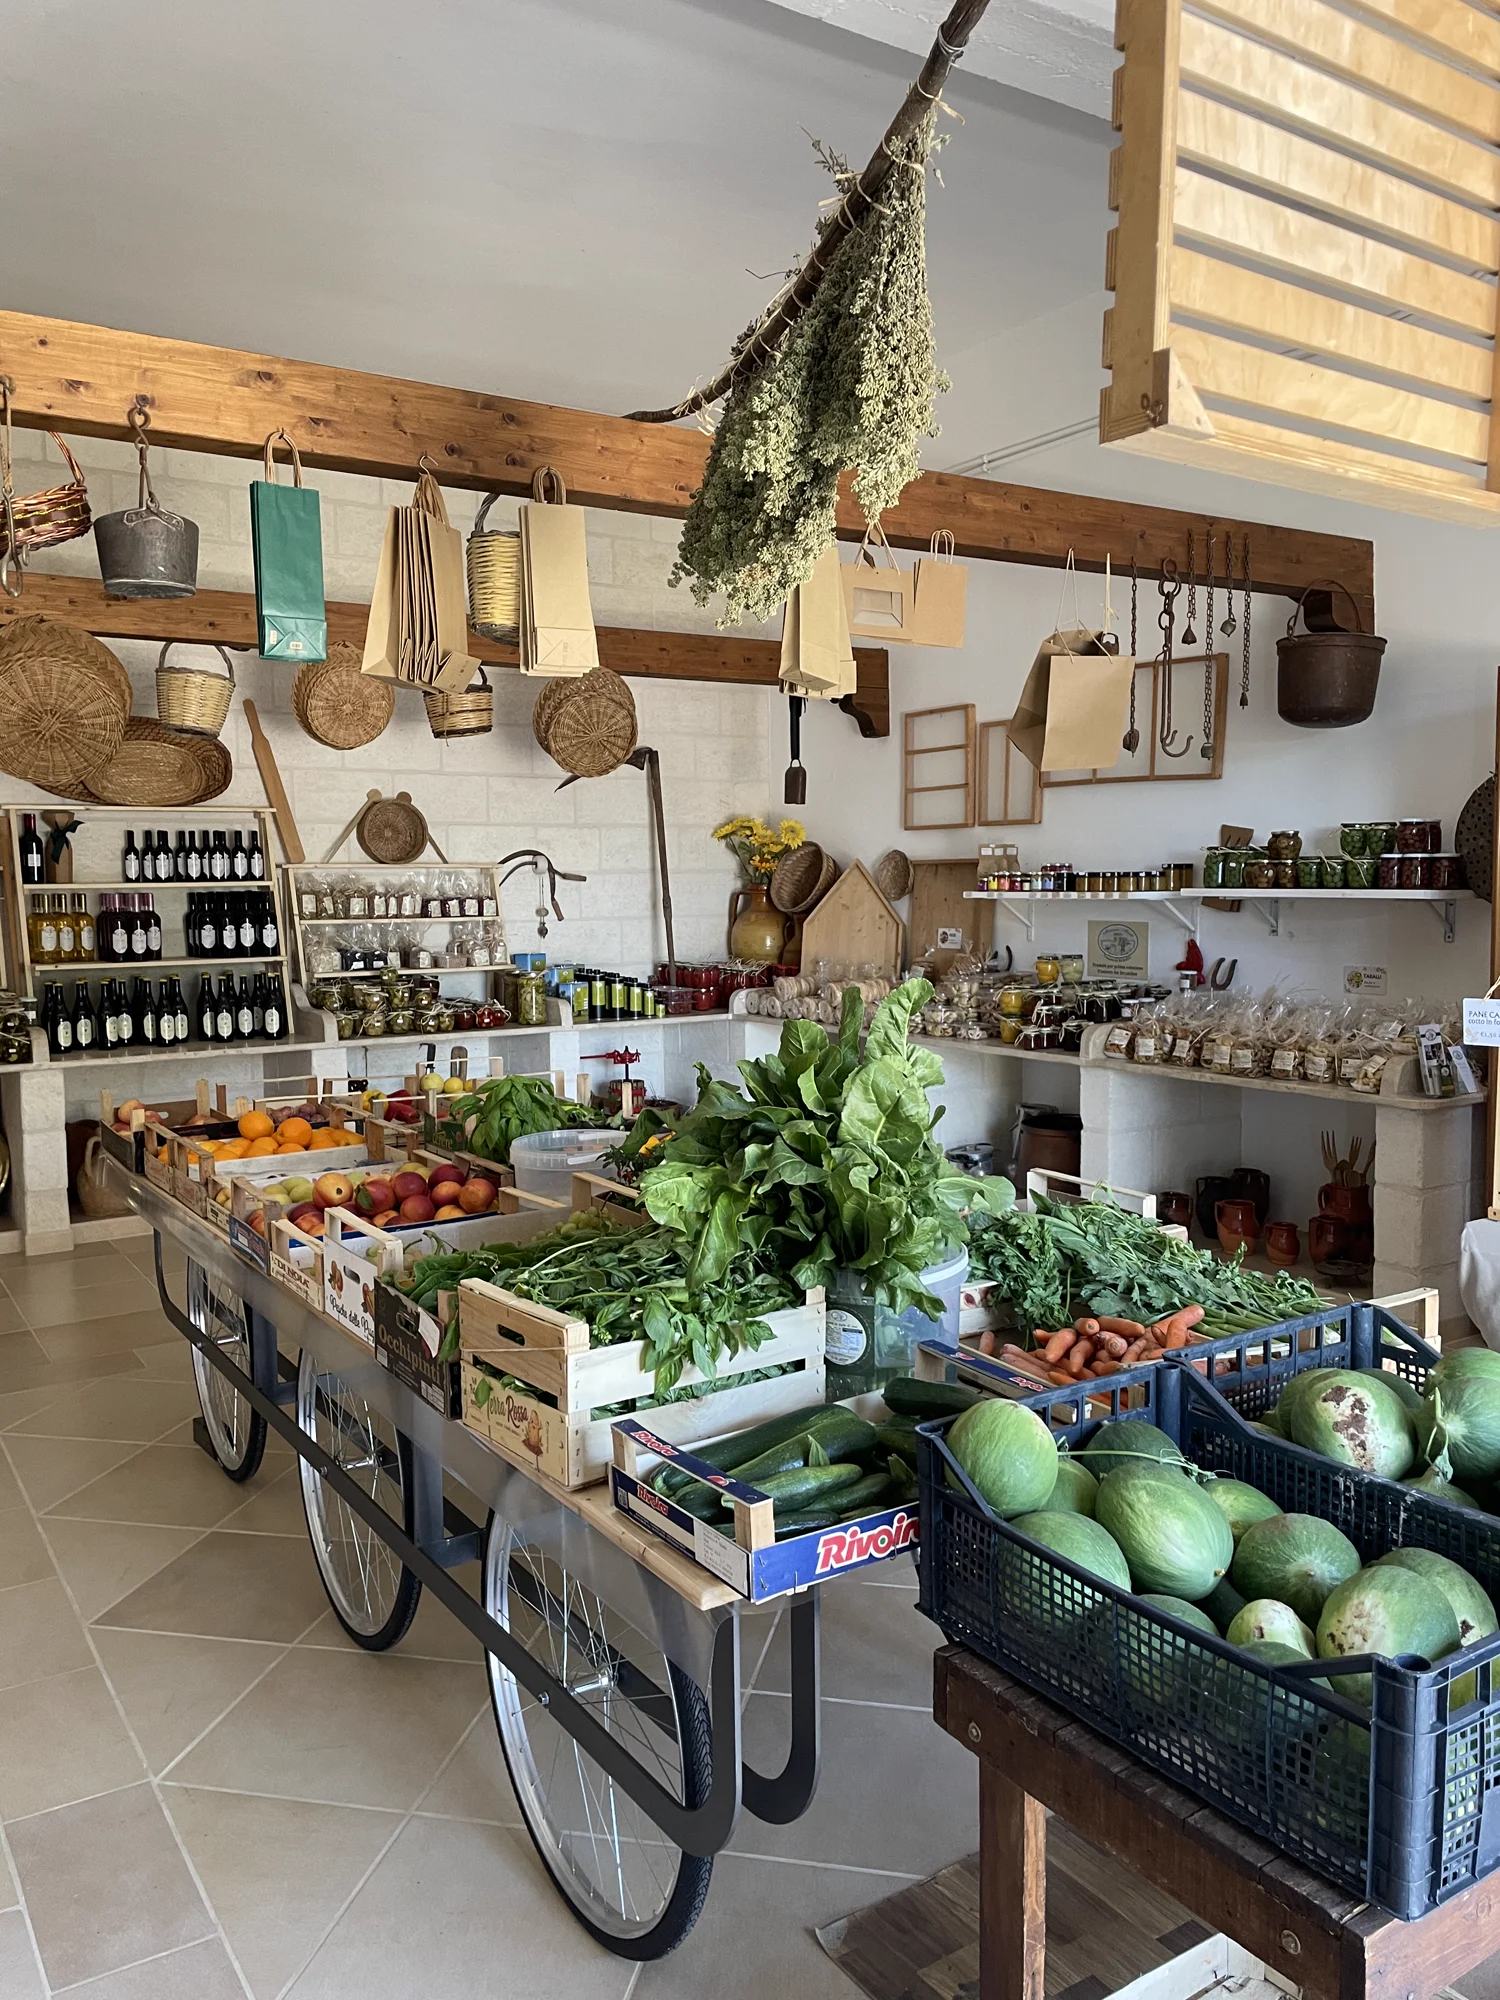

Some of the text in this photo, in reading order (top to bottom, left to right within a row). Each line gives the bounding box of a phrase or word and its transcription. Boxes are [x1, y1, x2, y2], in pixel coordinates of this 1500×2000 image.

[1468, 1010, 1500, 1019] PANE CA
[378, 1324, 441, 1385] Occhipinti
[506, 1395, 530, 1428] Rossa
[630, 1430, 679, 1457] Rivoira
[637, 1484, 669, 1516] Rivoira
[815, 1512, 920, 1575] Rivoir
